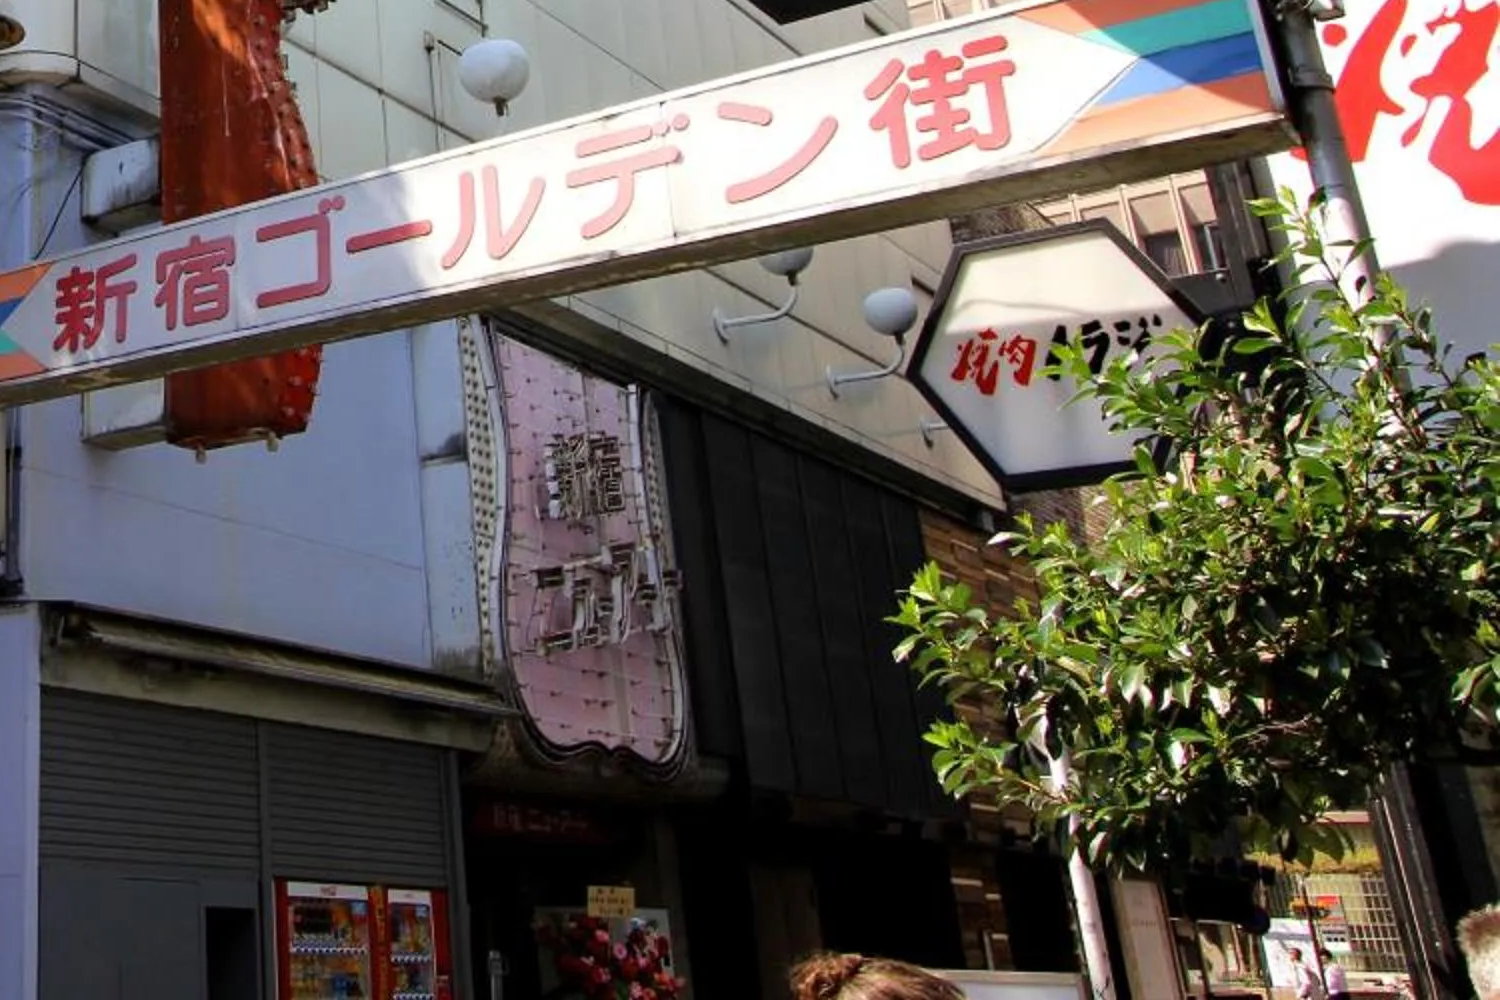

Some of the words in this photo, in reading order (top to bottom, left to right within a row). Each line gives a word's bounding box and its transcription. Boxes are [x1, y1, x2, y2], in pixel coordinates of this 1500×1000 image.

[52, 35, 1015, 352] 新宿ゴールデン街
